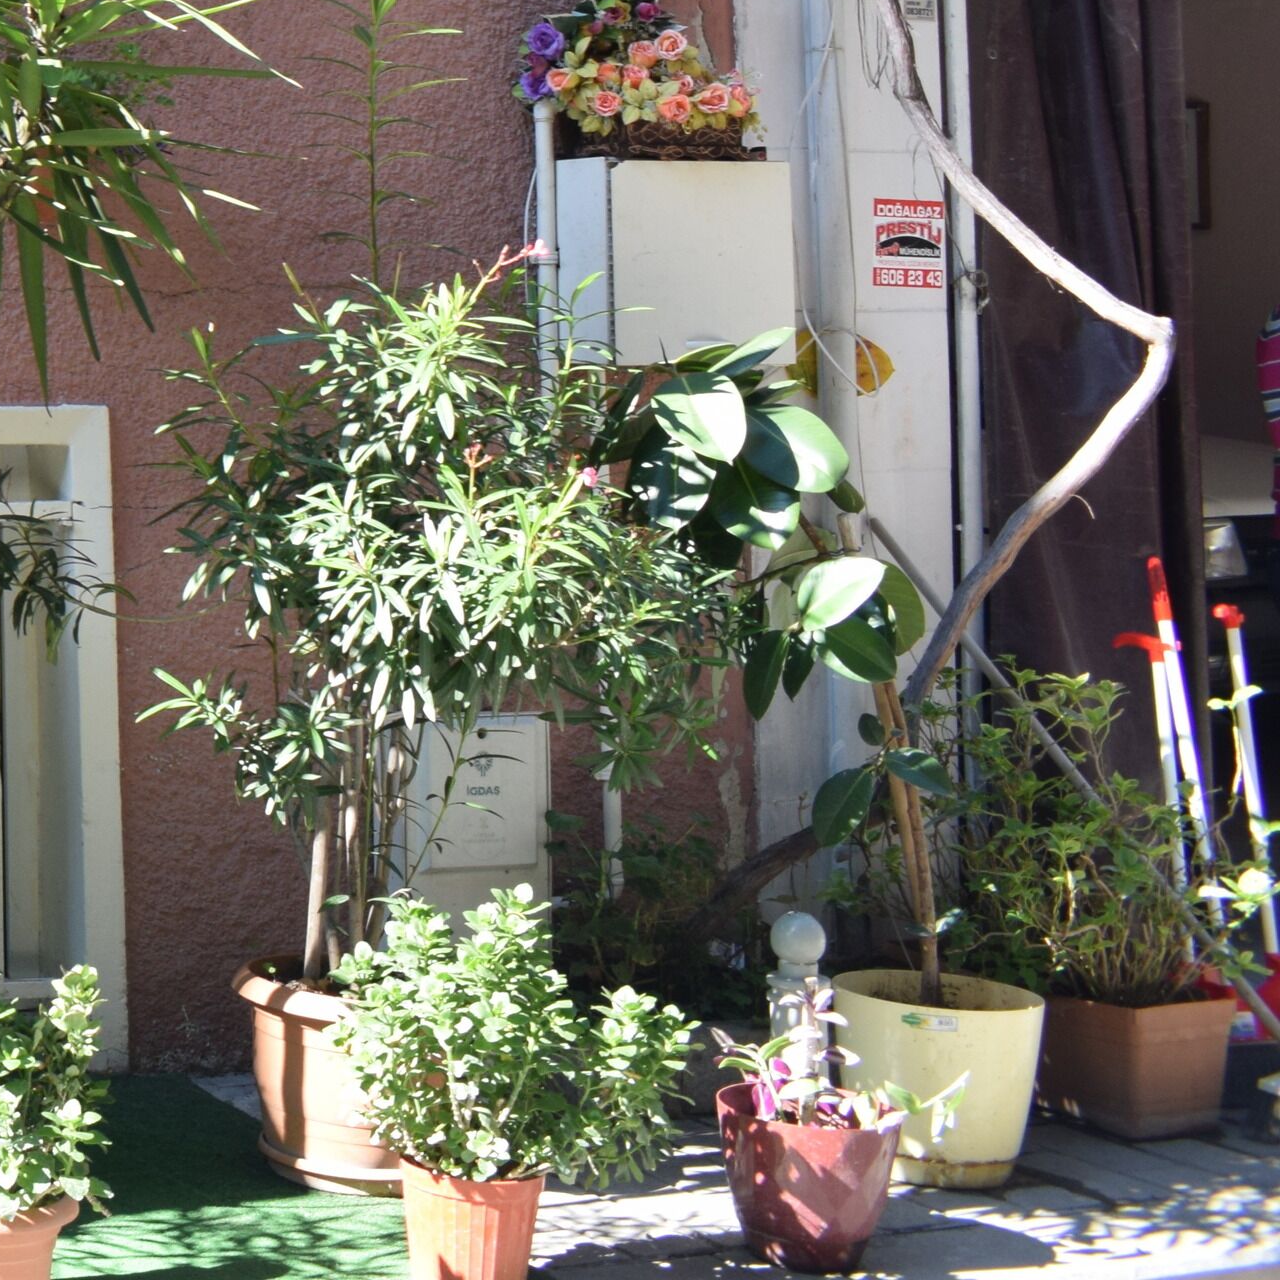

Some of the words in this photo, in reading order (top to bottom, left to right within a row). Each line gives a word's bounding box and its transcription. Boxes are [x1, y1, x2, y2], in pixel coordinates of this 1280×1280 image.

[877, 203, 940, 218] DOĞALGAZ
[876, 220, 941, 245] PRESTİJ
[881, 269, 904, 285] 606
[907, 270, 923, 286] 23
[926, 271, 942, 286] 43
